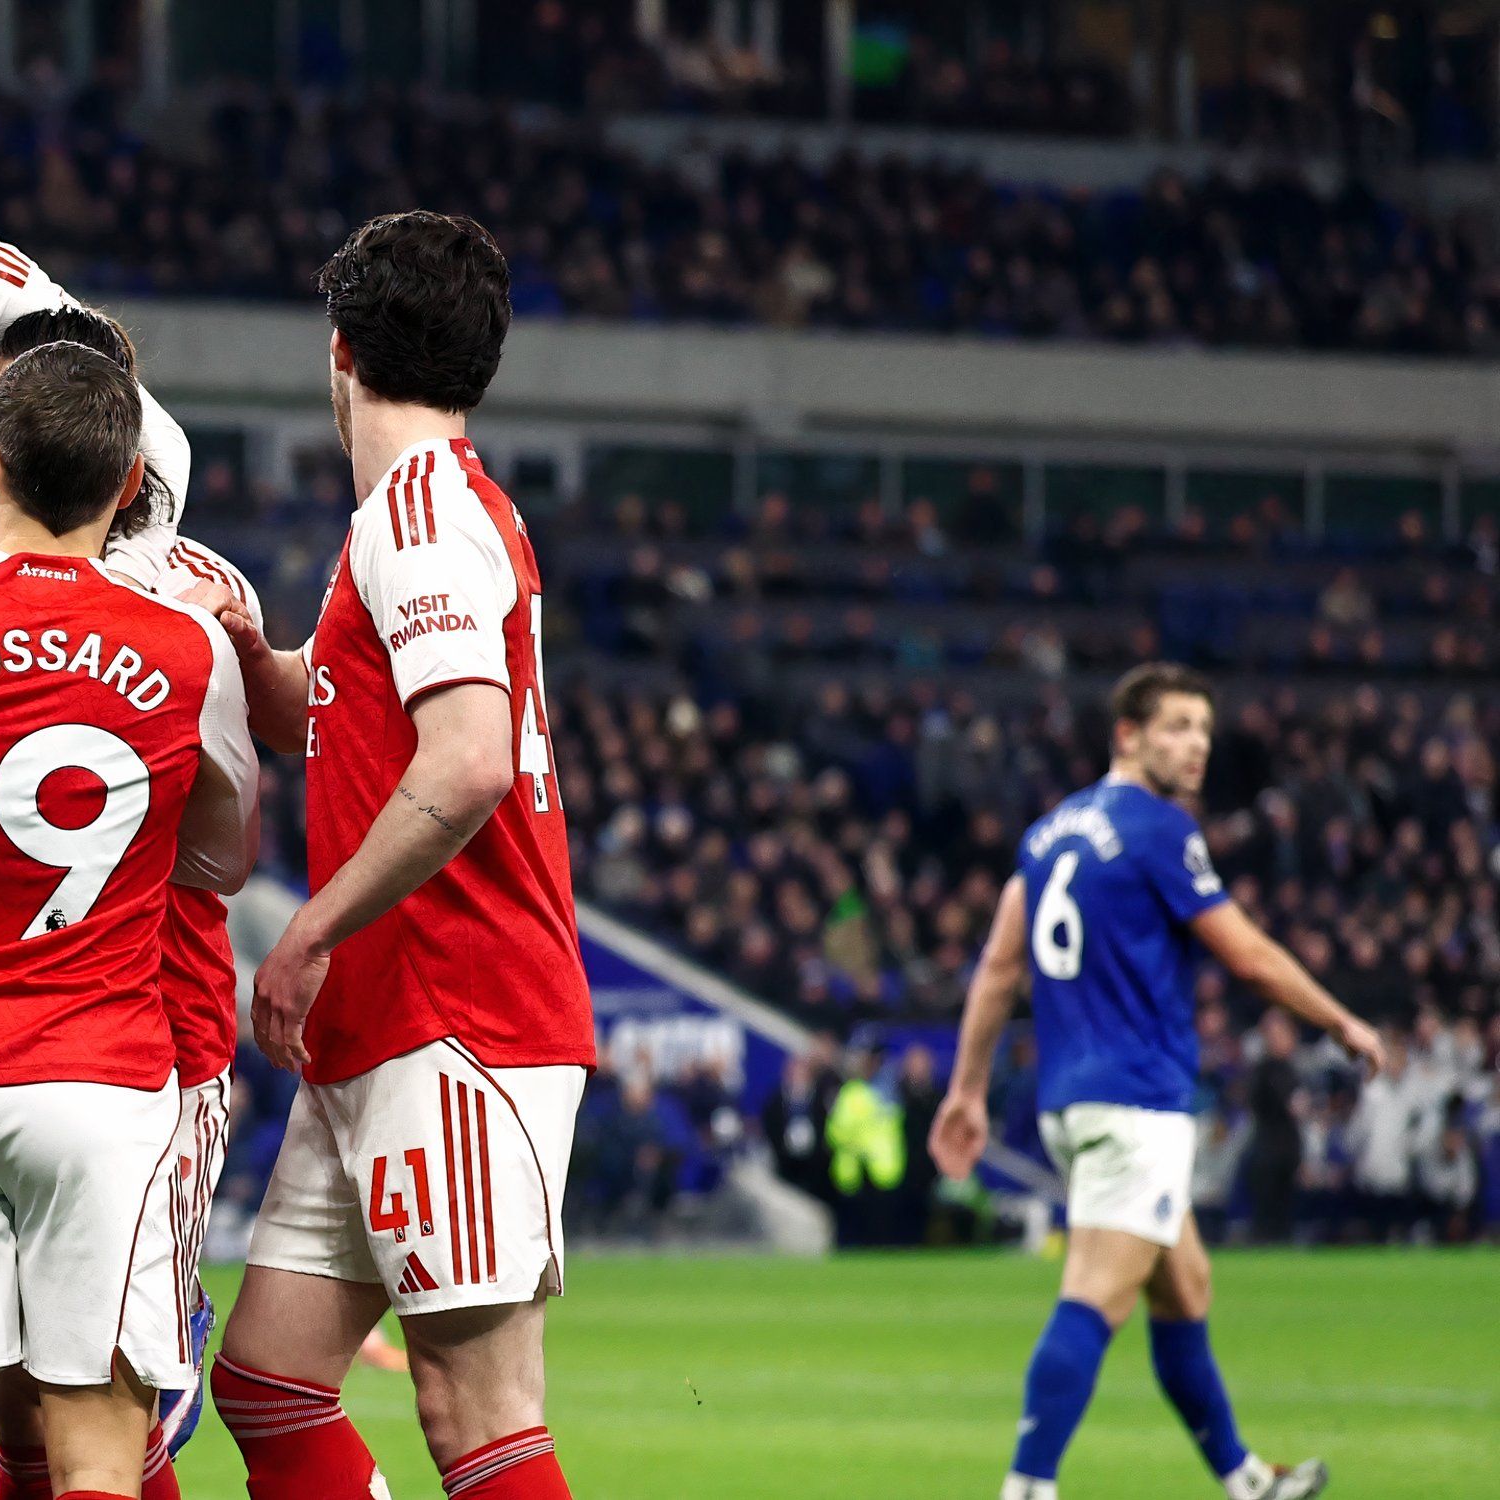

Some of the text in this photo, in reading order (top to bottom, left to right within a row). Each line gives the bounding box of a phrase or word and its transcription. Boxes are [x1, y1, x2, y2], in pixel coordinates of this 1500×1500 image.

[16, 562, 78, 582] Arsenal
[397, 593, 450, 621] VISIT
[389, 614, 478, 653] RWANDA
[1032, 850, 1084, 981] 6
[369, 1147, 434, 1243] 41
